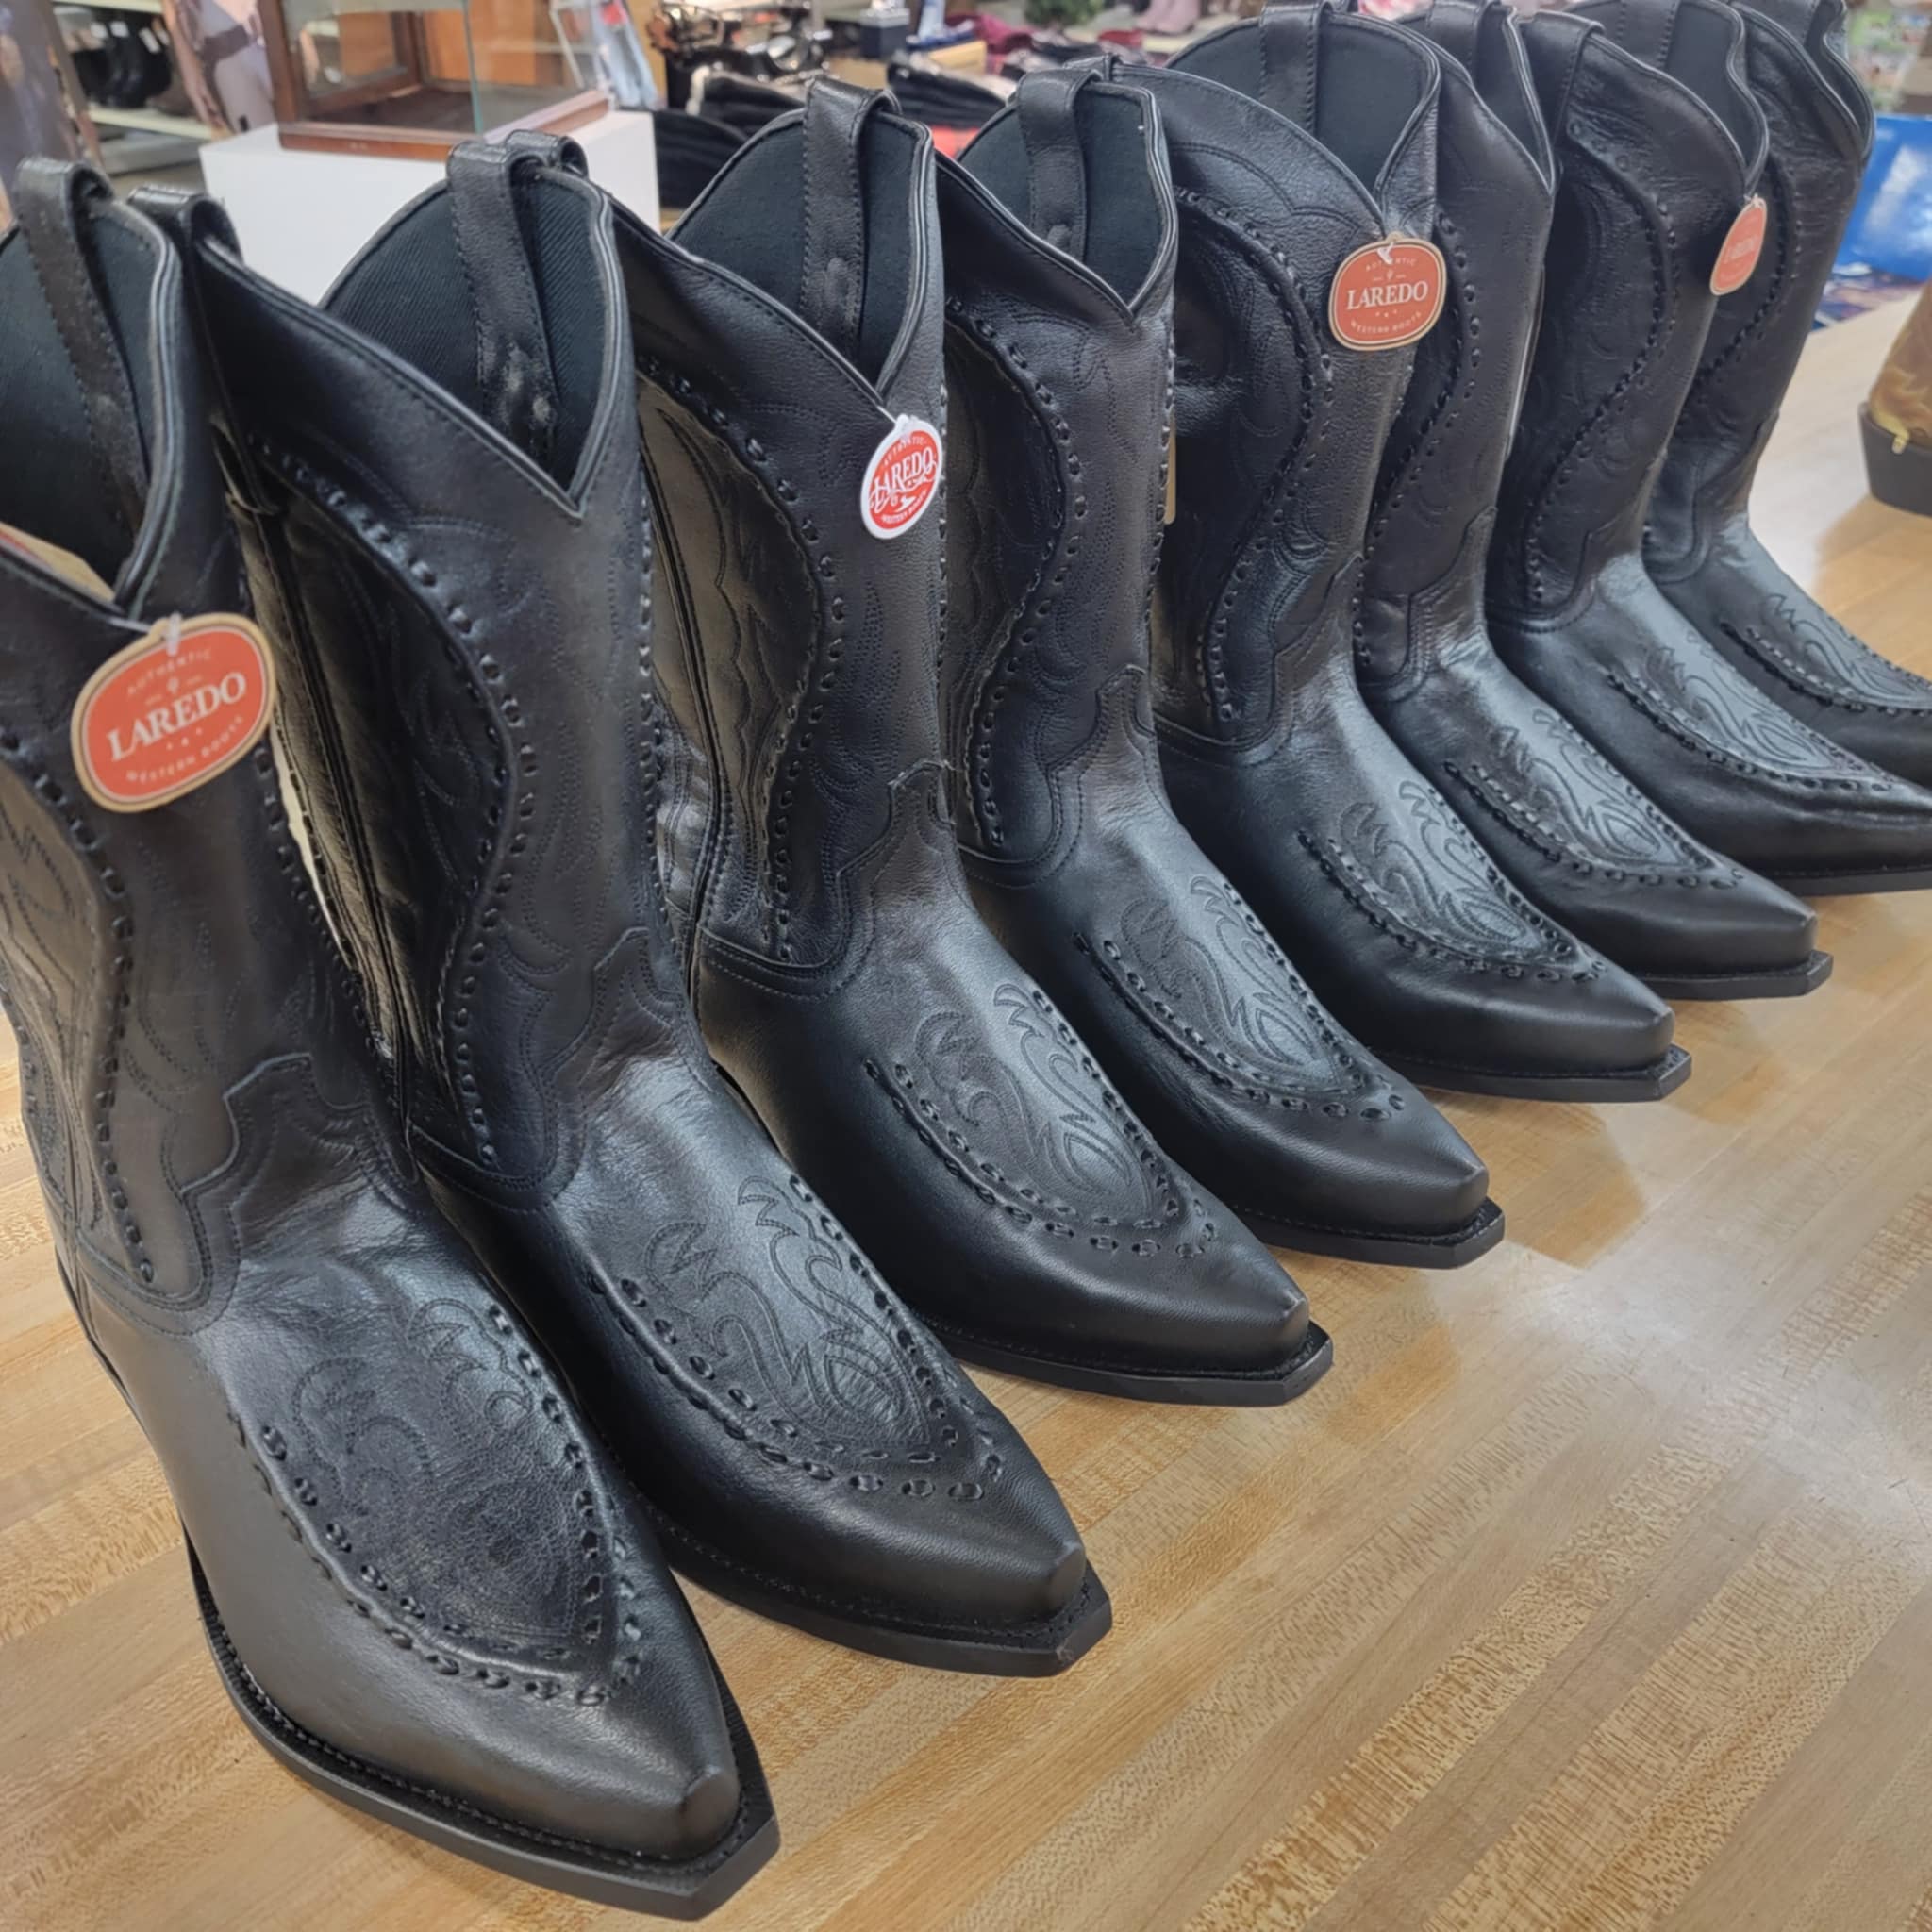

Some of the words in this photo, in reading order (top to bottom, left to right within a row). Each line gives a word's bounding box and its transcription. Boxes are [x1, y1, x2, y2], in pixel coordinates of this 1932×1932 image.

[1346, 280, 1429, 310] LAREDO
[870, 446, 938, 514] LAREDO
[106, 671, 247, 762] LAREDO
